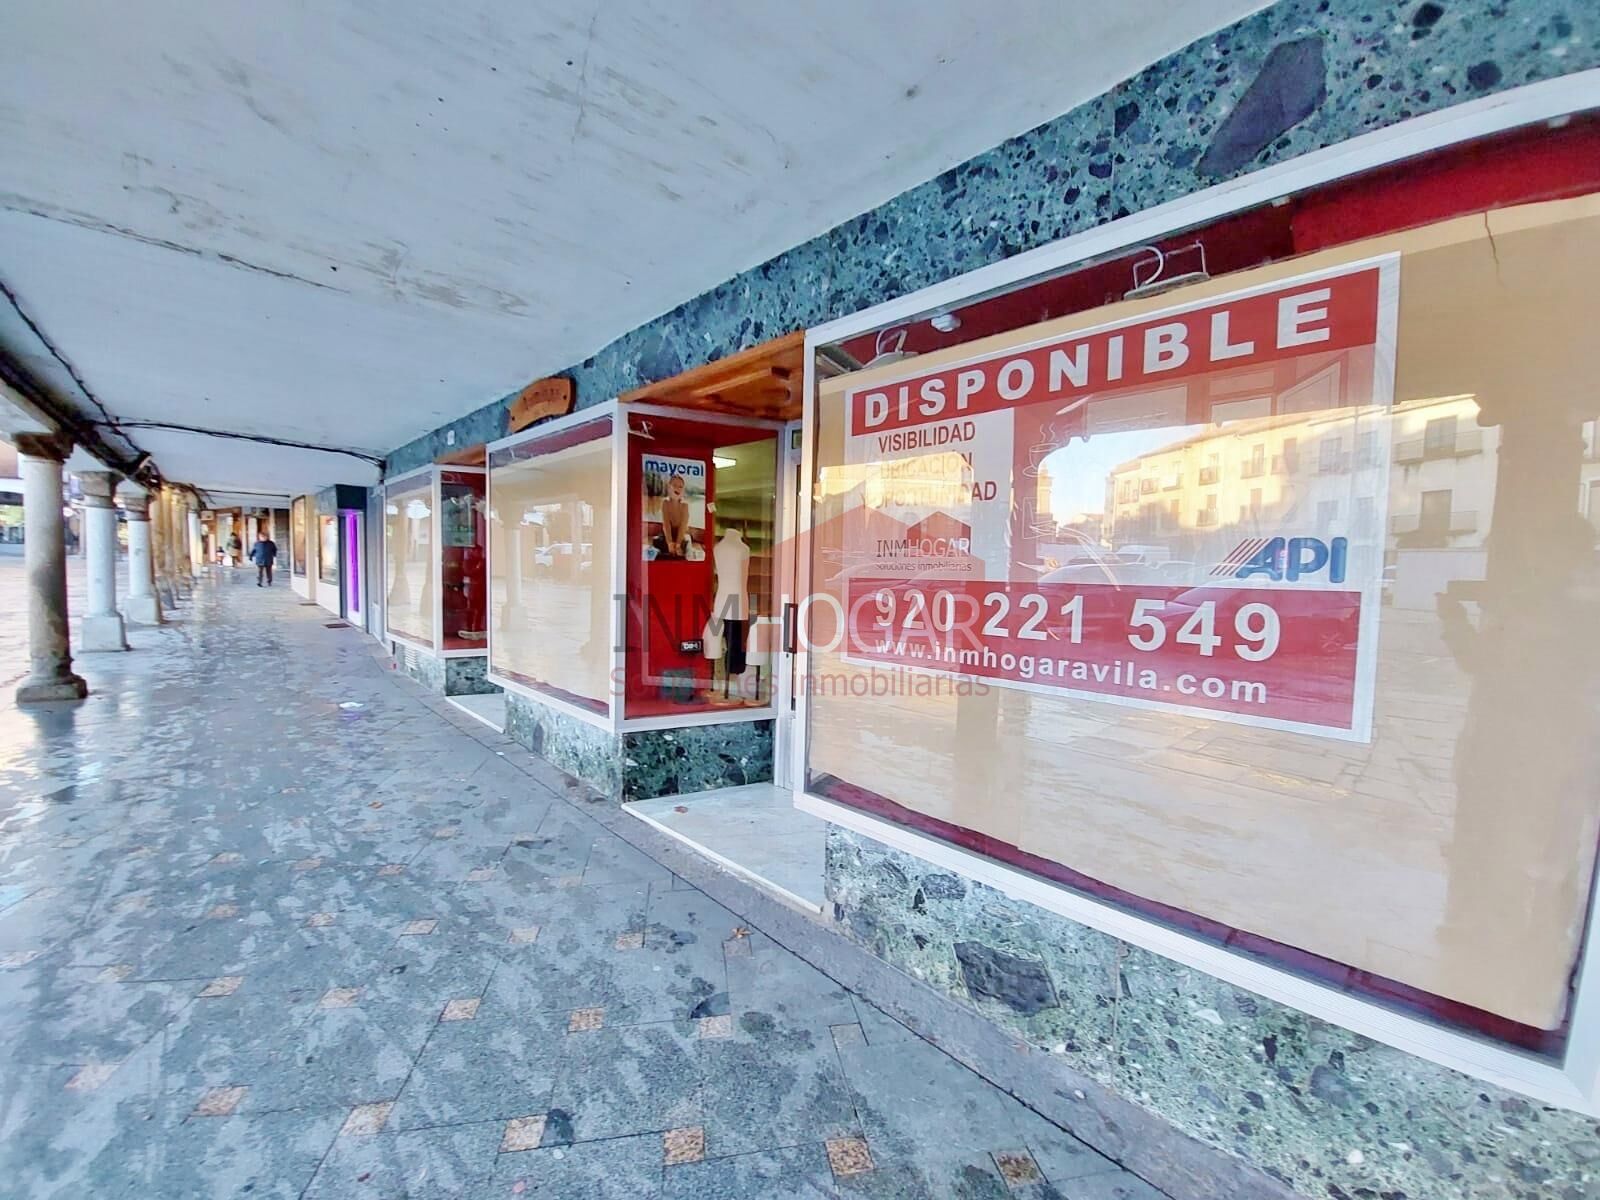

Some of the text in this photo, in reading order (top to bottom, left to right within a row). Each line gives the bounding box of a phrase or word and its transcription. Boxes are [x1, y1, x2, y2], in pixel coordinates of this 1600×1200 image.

[864, 287, 1331, 428] DISPONIBLE
[878, 421, 976, 453] VISIBILIDAD
[645, 460, 704, 477] mayoral
[876, 538, 971, 558] INMHOGAR
[1235, 536, 1348, 583] API
[874, 588, 1282, 662] 920 221 549
[875, 636, 1269, 704] www.inmhogaravila.com
